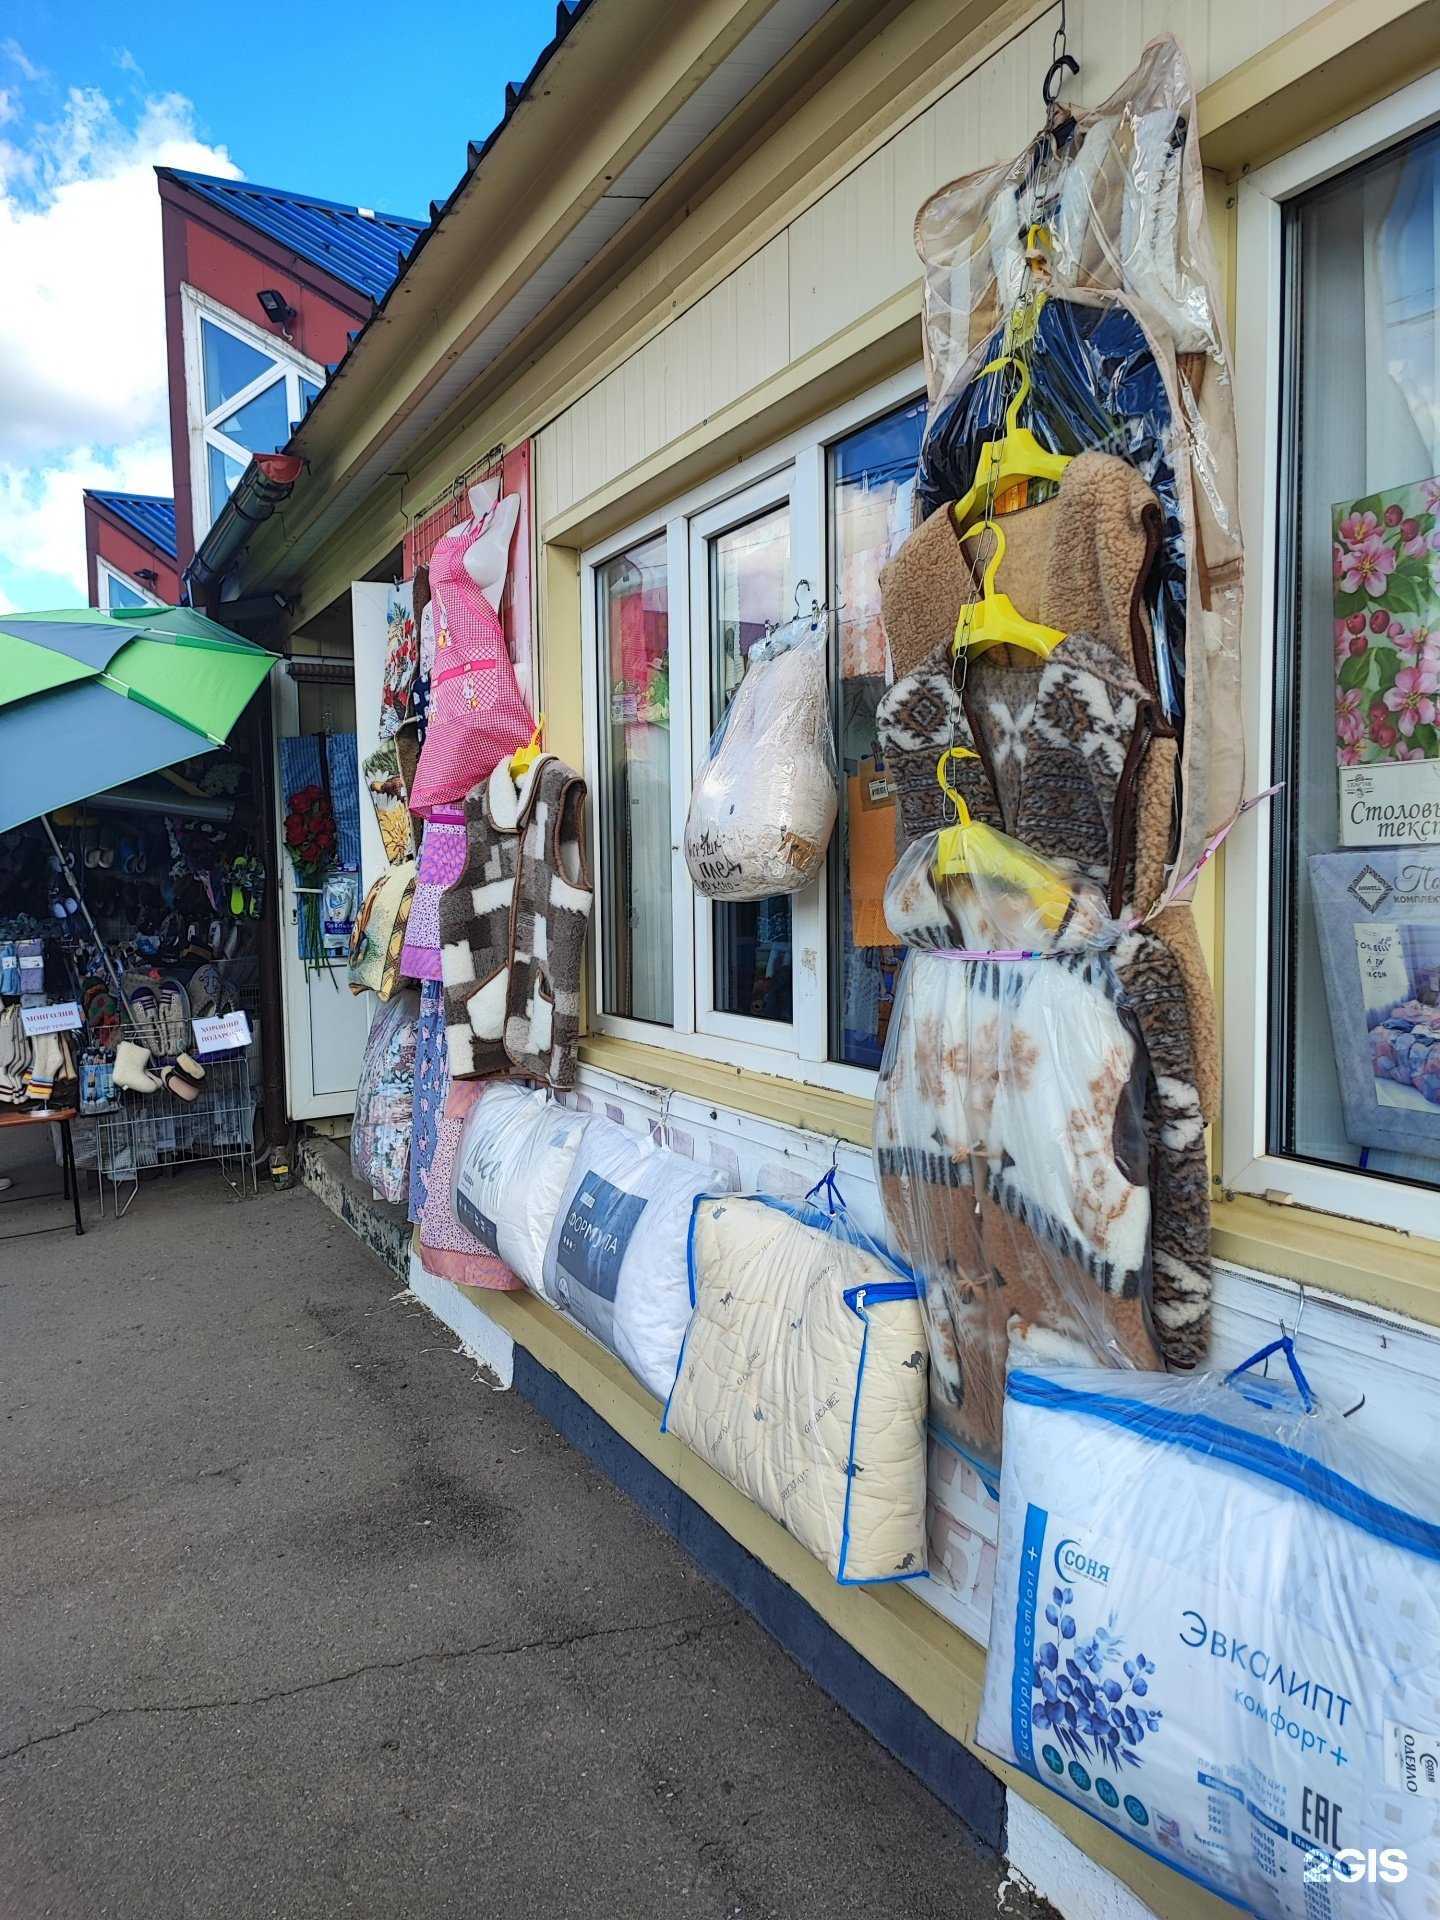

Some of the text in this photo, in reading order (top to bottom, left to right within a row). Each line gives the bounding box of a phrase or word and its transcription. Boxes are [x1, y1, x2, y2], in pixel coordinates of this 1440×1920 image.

[1064, 1548, 1111, 1583] СОНЯ
[1179, 1610, 1352, 1726] Эвкалипт
[1403, 1734, 1418, 1793] ОДЕЯЛО
